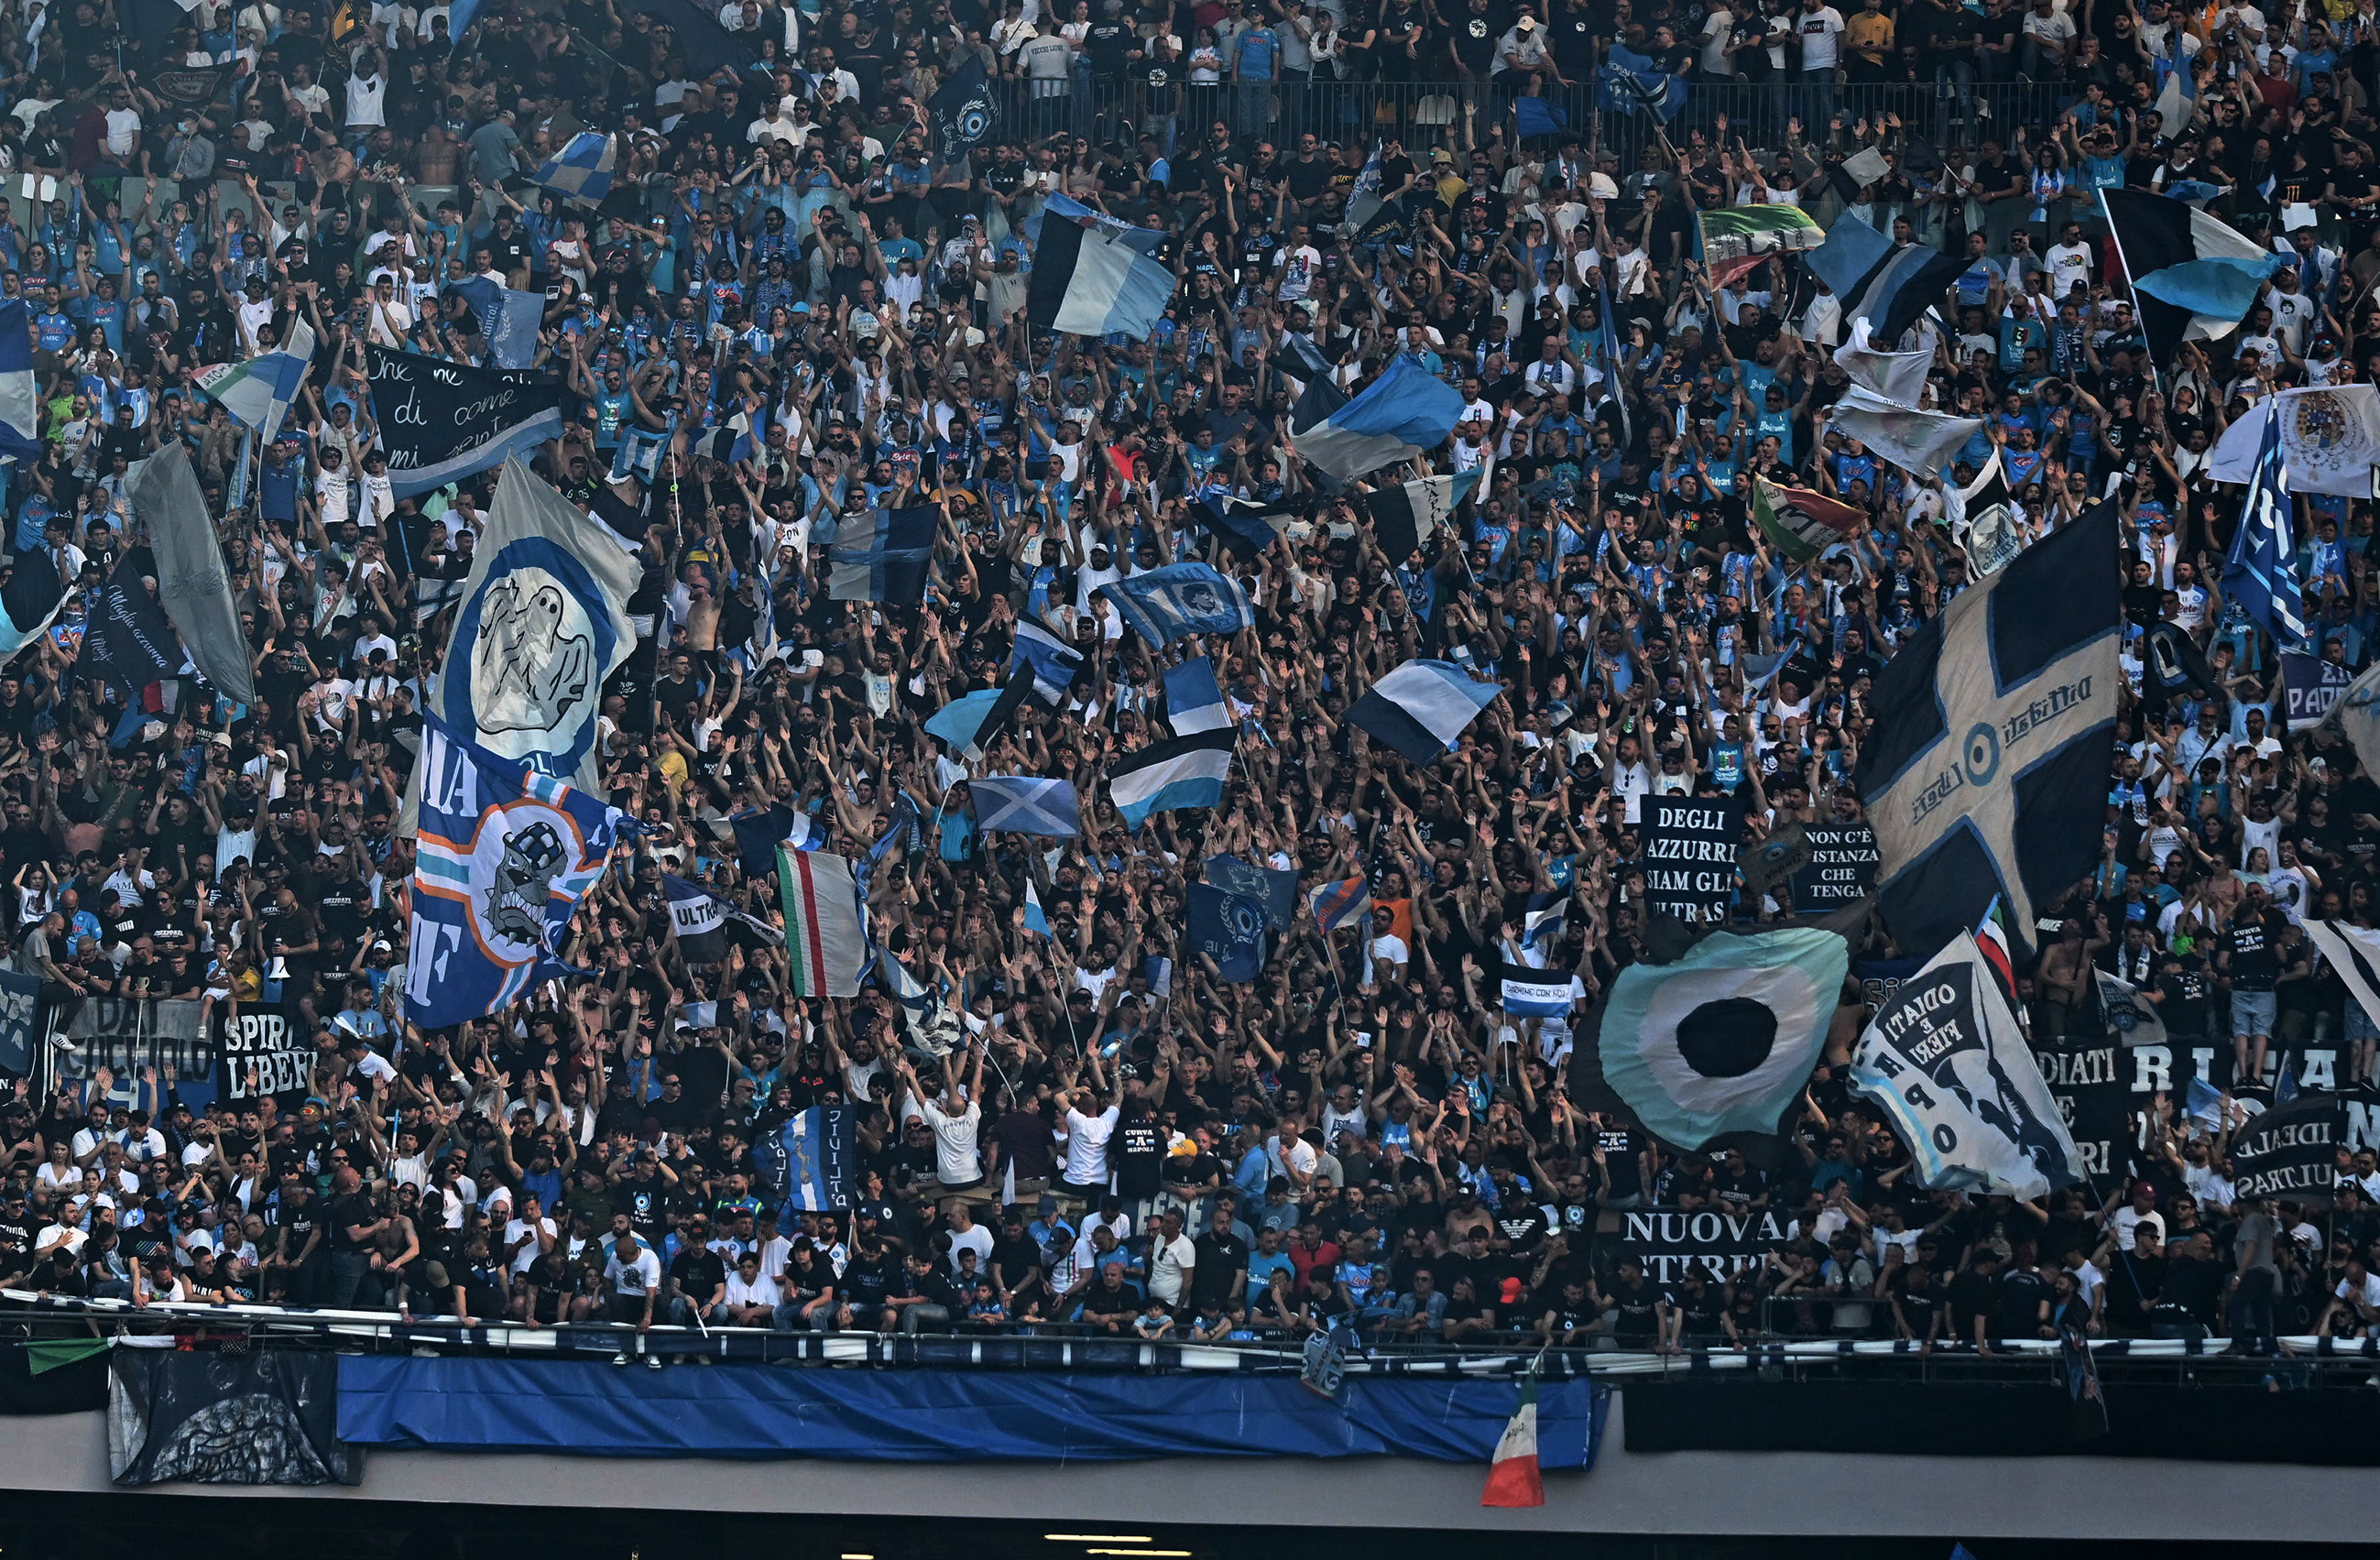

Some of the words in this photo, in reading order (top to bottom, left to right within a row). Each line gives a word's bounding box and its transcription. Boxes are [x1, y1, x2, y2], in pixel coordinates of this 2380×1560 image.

[395, 386, 427, 425] di
[454, 389, 519, 425] come
[1759, 420, 1786, 432] Buitoni
[64, 437, 81, 446] Lete
[388, 445, 425, 469] mi
[890, 453, 912, 462] Lete
[1657, 807, 1724, 831] DEGLI
[1806, 831, 1840, 844] NON
[1647, 838, 1736, 863] AZZURRI
[1812, 849, 1879, 863] ISTANZA
[1646, 868, 1689, 891] SIAM
[1693, 869, 1732, 892] GLI
[1821, 868, 1855, 881] CHE
[1811, 884, 1864, 900] TENGA
[2036, 918, 2063, 932] NIKE
[2233, 927, 2261, 937] CURVA
[2245, 935, 2255, 948] A
[2234, 944, 2263, 954] NAPOLI
[1536, 988, 1550, 998] CON
[2036, 1049, 2115, 1085] DIATI
[1135, 1136, 1145, 1147] A
[1610, 1137, 1619, 1147] A
[1623, 1211, 1785, 1243] NUOVA
